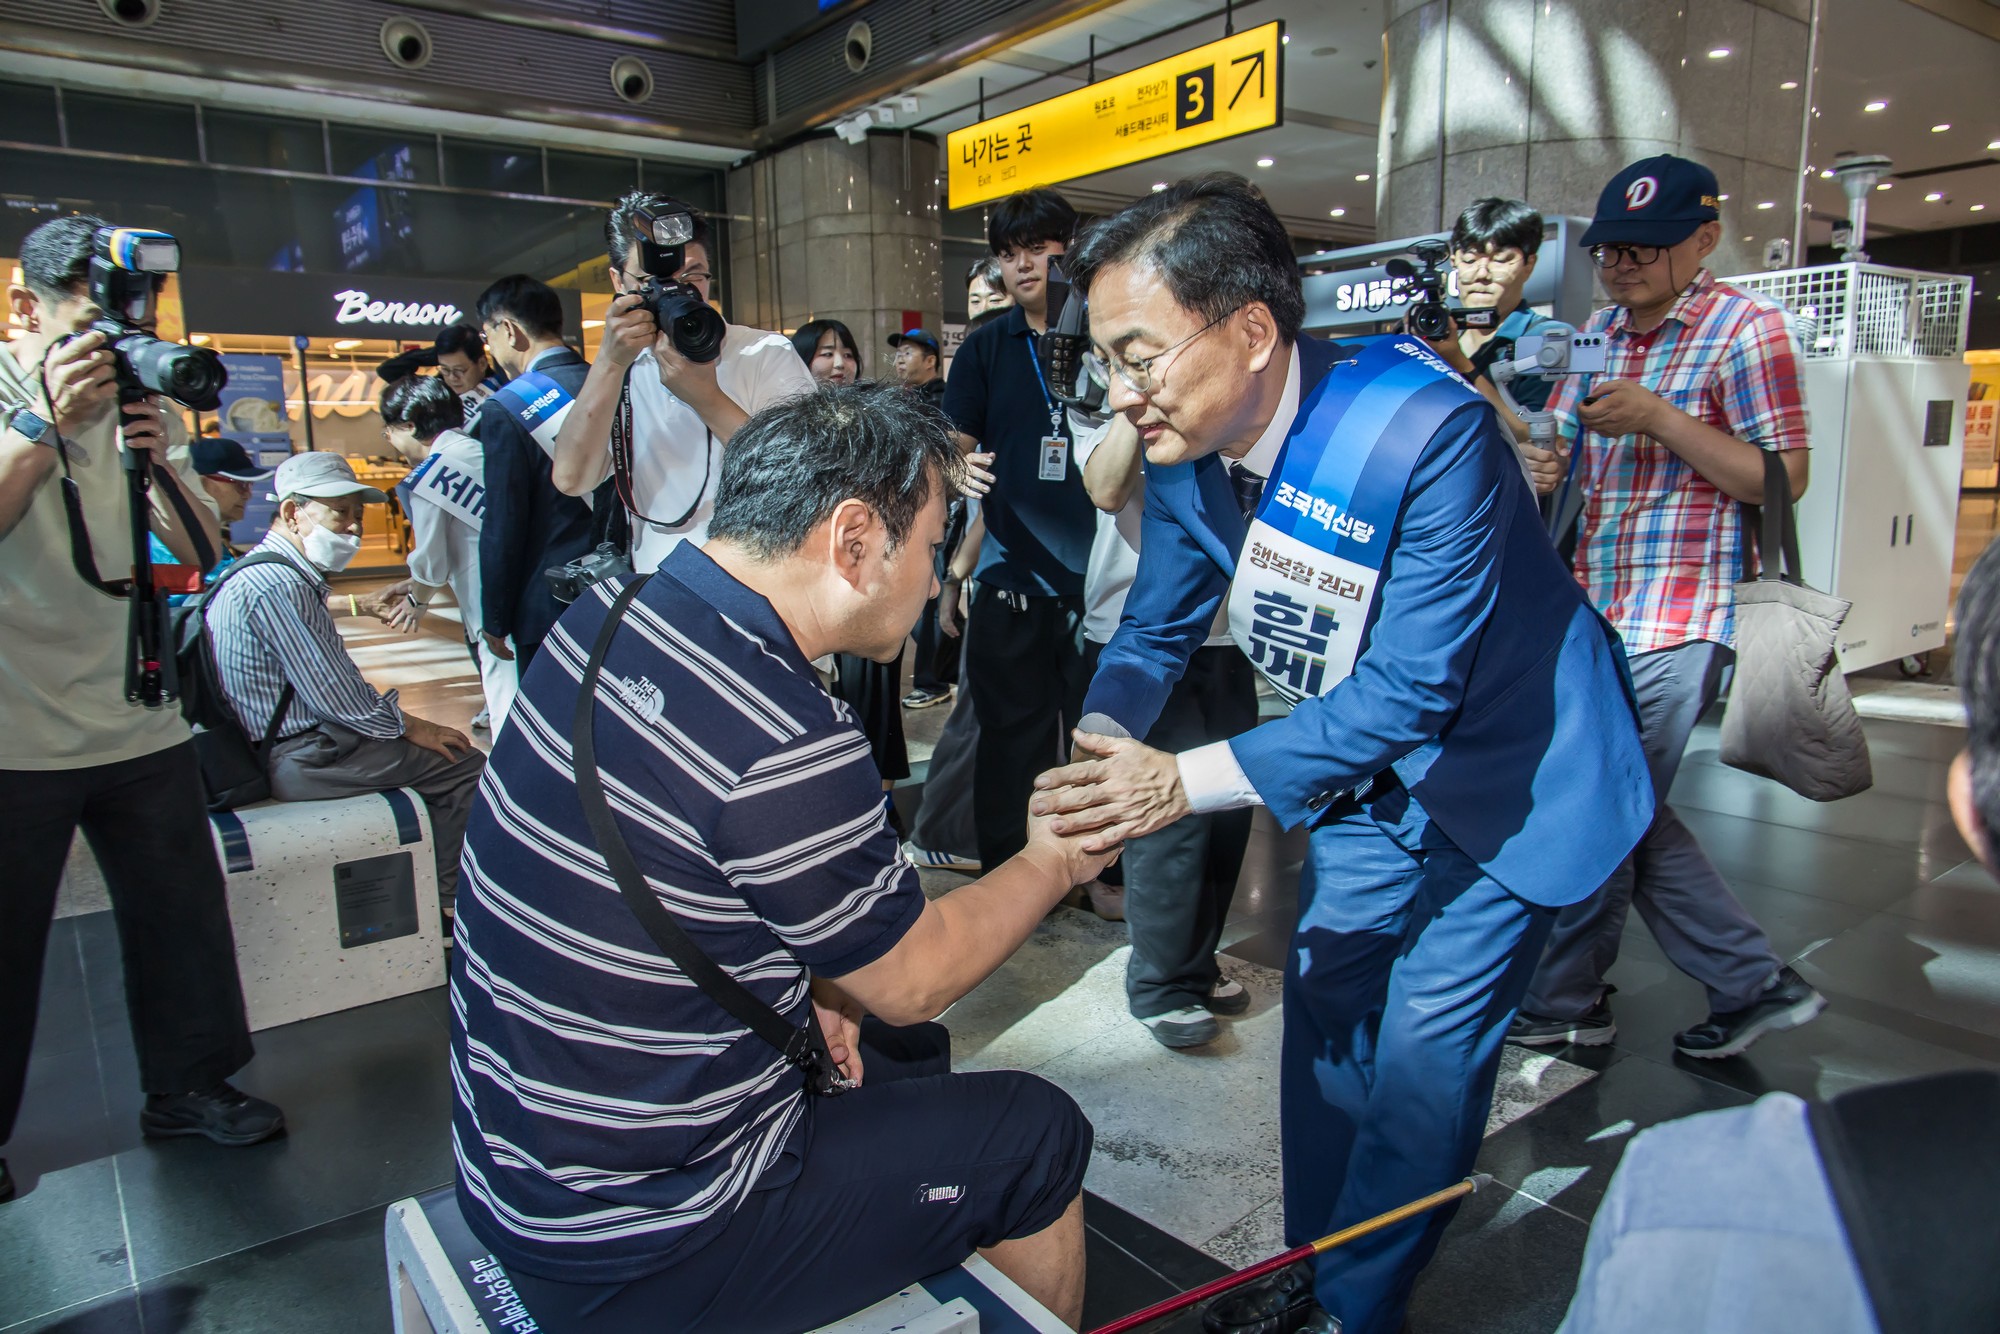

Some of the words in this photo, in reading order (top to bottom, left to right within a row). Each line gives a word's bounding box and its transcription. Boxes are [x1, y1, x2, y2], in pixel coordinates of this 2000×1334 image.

[1185, 76, 1205, 120] 3
[1115, 112, 1169, 137] 서울드래곤시티
[963, 133, 1010, 168] 나가는
[1017, 123, 1033, 155] 곳
[978, 174, 992, 187] Exit
[1625, 176, 1659, 211] D
[334, 289, 464, 326] Benson
[1336, 269, 1461, 312] SAMS
[520, 388, 562, 421] 조국혁신당
[1274, 481, 1375, 544] 조국혁신당
[1250, 541, 1315, 587] 행복할
[1317, 570, 1365, 602] 권리
[618, 691, 644, 712] FACE
[620, 676, 650, 703] NORTH
[638, 675, 658, 695] THE
[928, 1185, 959, 1202] PUMA
